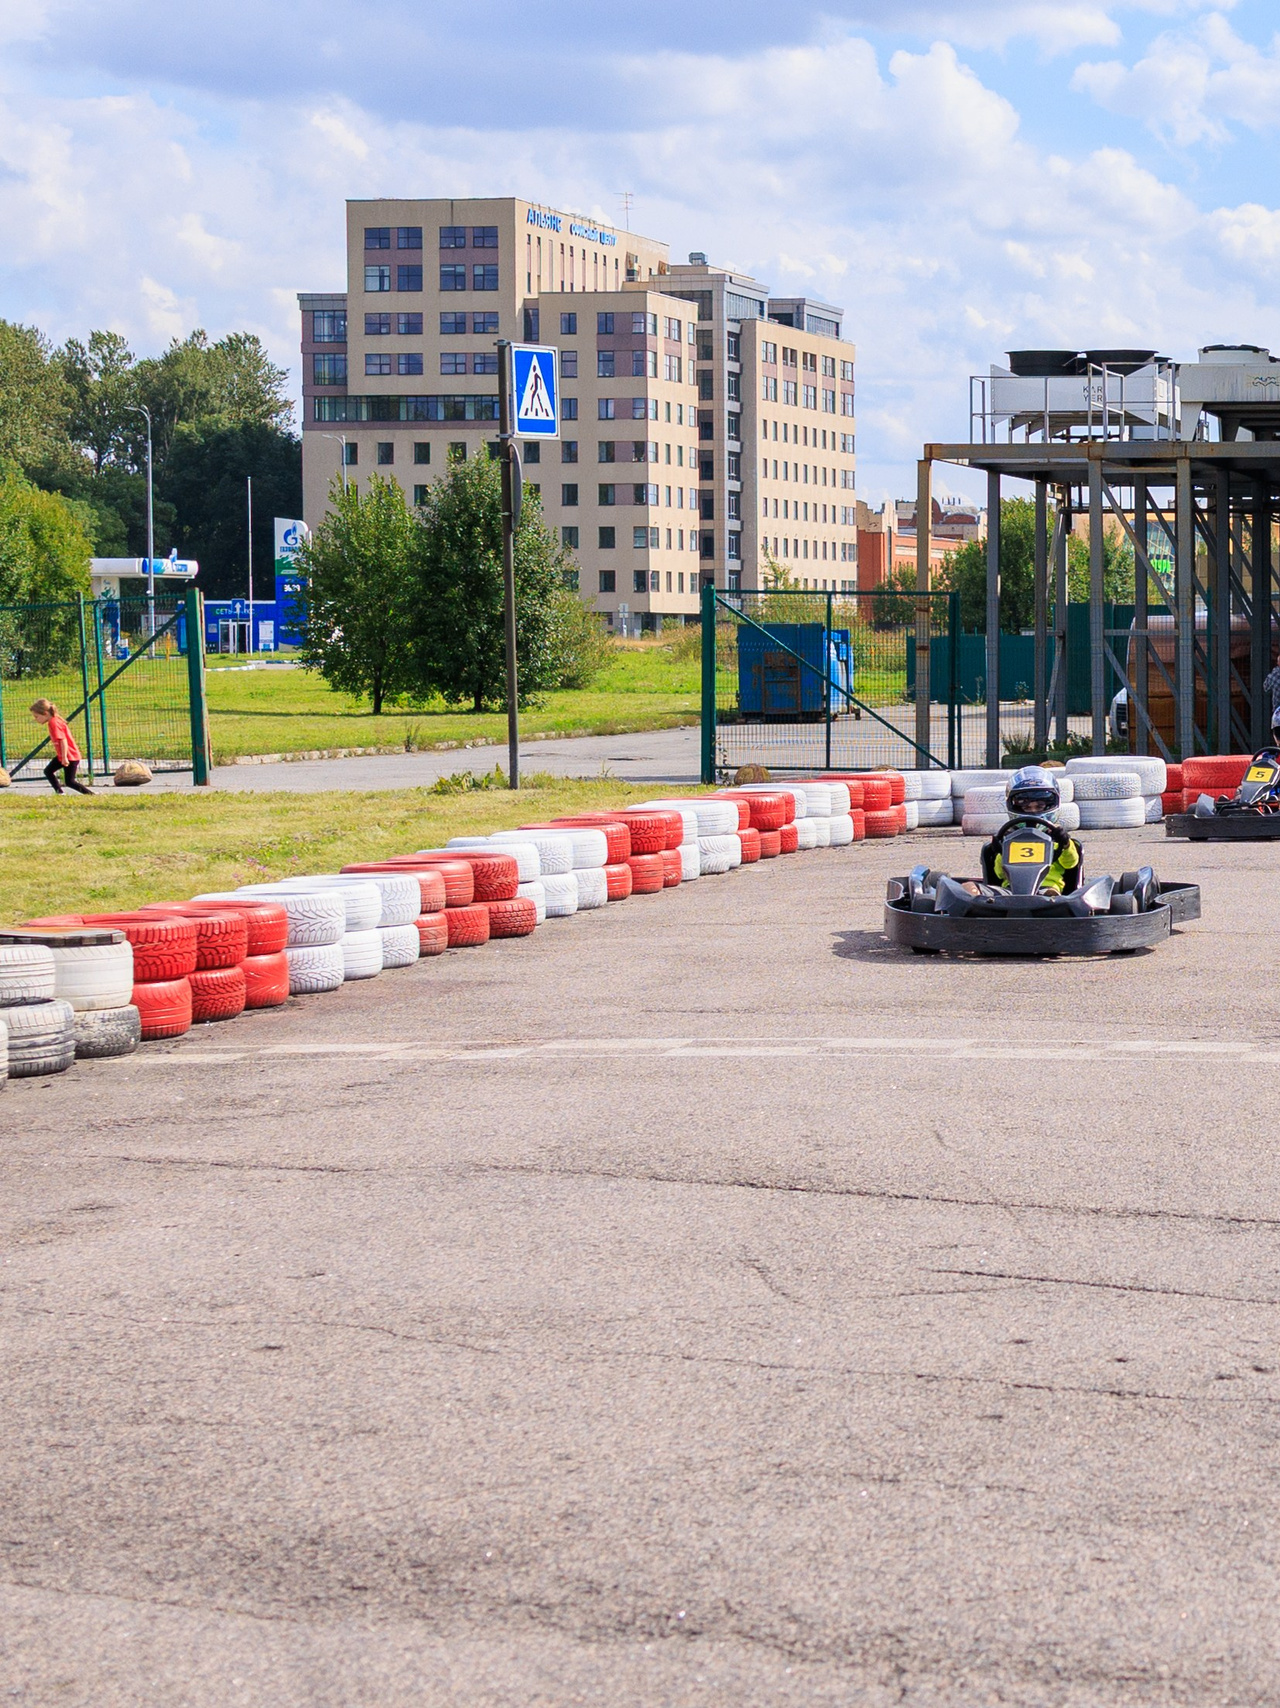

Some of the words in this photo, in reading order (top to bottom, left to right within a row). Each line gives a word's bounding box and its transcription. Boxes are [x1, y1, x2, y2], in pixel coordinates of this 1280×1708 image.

[527, 208, 562, 233] АЛЬЯНС
[1255, 771, 1266, 779] 5
[1020, 847, 1034, 858] 3
